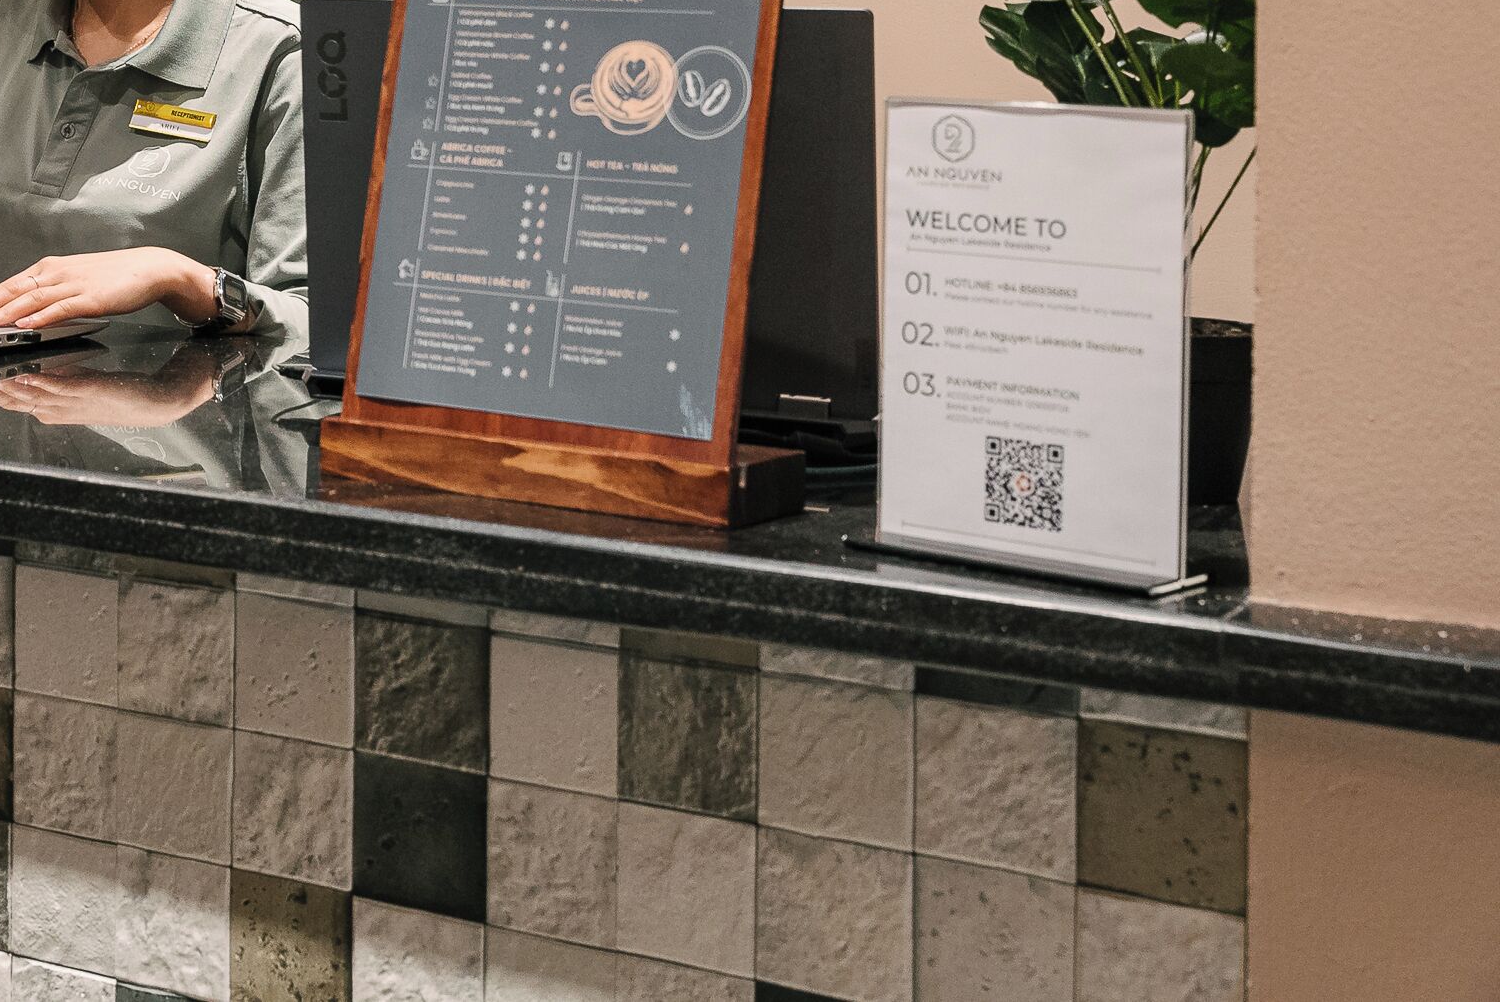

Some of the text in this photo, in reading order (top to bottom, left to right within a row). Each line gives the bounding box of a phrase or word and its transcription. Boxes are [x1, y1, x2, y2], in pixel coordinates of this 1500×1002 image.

[170, 109, 206, 122] RECEPTIONIST
[905, 165, 1003, 183] AN NGUYEN
[93, 176, 182, 202] AN NGUYEN
[905, 209, 1067, 240] WELCOME TO
[904, 270, 938, 297] 01.
[901, 320, 941, 348] 02.
[902, 371, 942, 399] 03.
[945, 375, 1080, 402] PAYMENT INFORMATION
